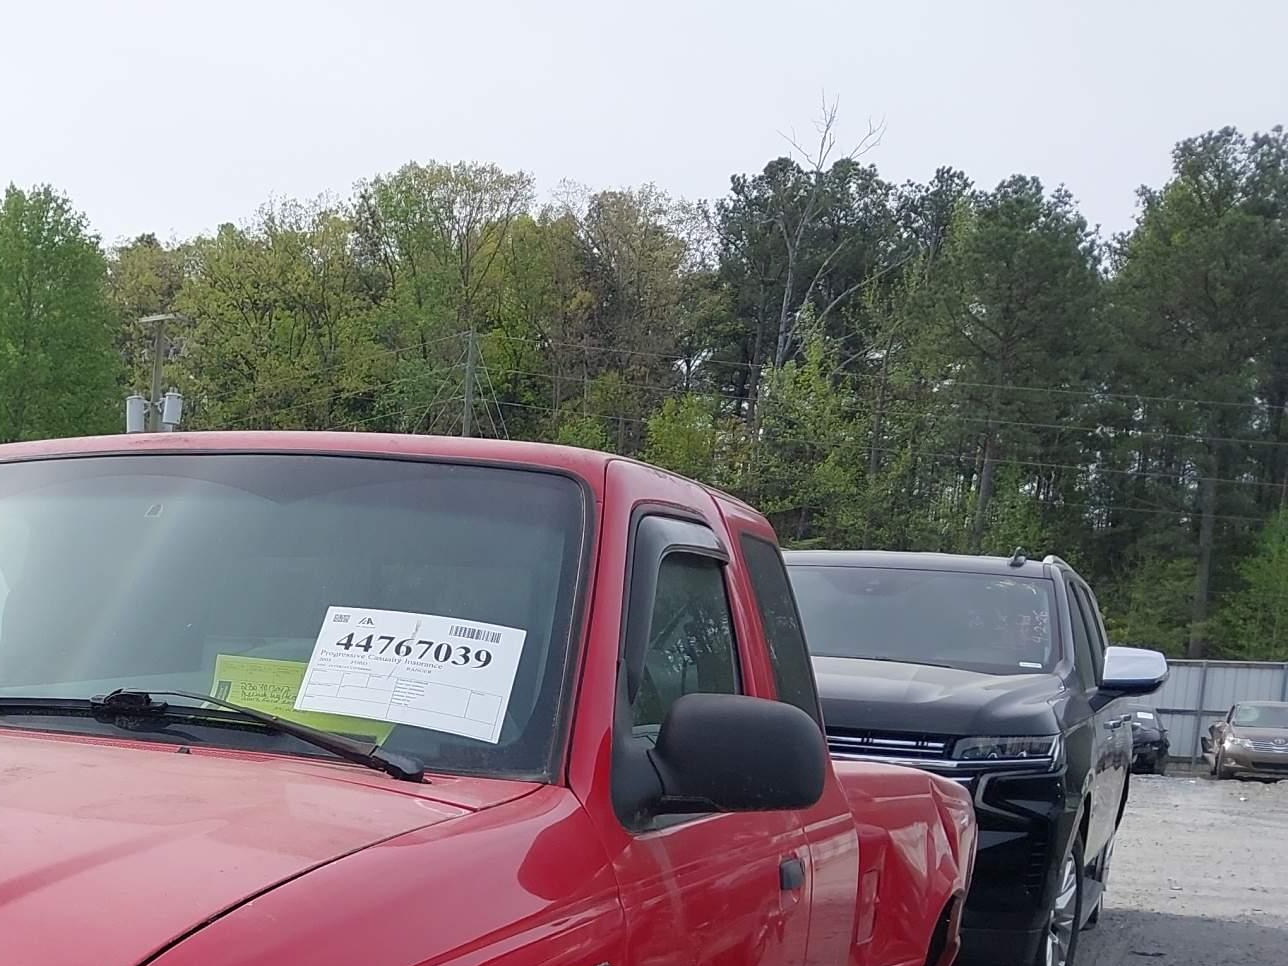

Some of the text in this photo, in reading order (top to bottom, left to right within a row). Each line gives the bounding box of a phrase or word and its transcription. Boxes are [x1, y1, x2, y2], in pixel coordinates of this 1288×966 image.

[320, 648, 444, 670] Progressive Casualty Insurance
[335, 632, 493, 669] 44767039
